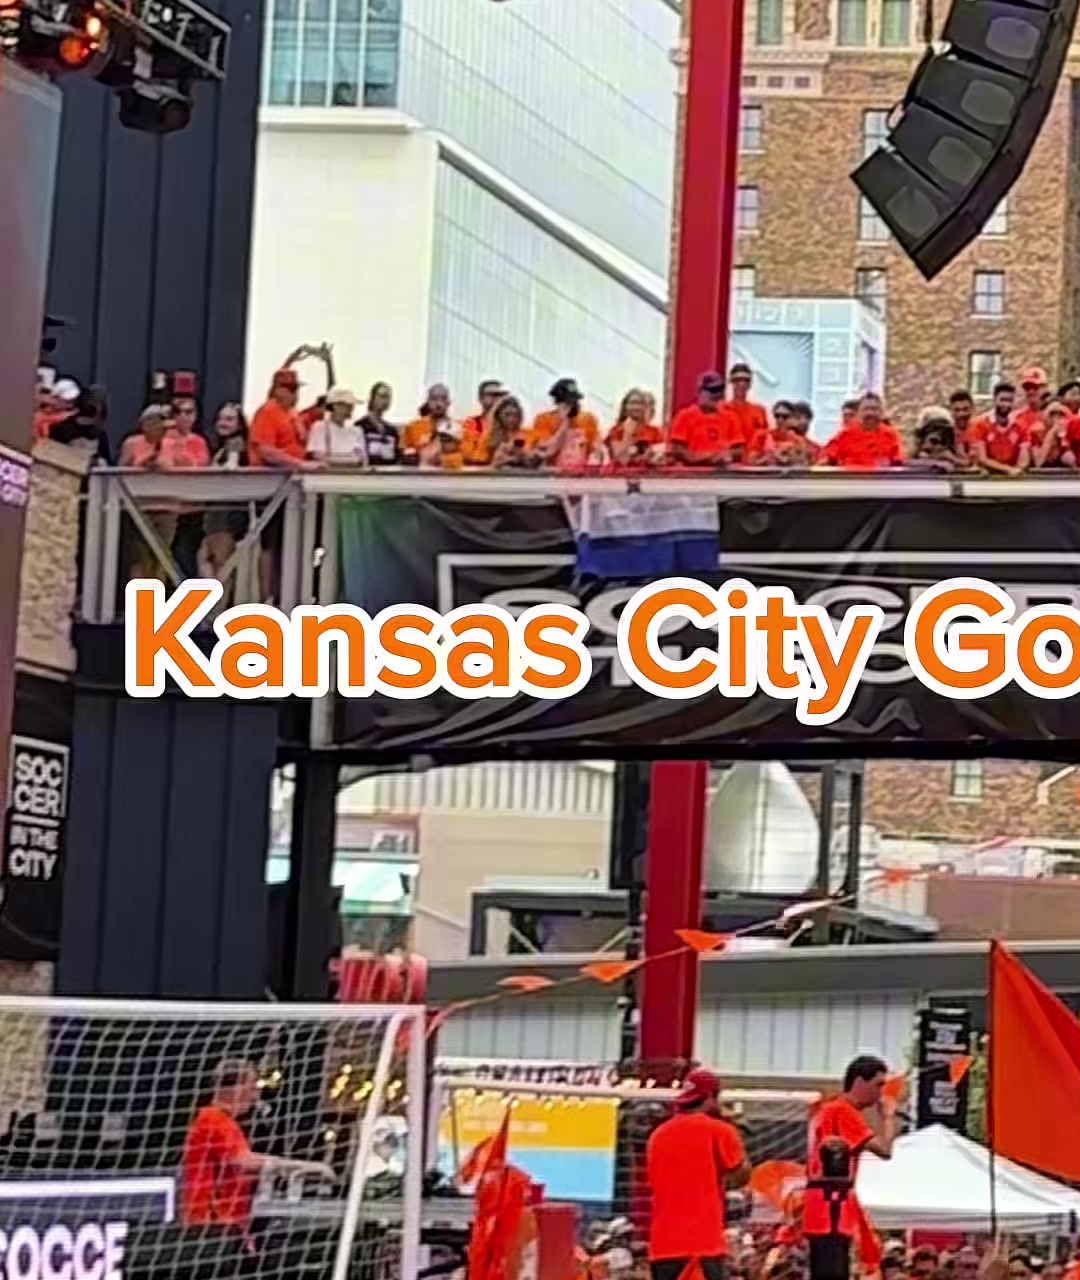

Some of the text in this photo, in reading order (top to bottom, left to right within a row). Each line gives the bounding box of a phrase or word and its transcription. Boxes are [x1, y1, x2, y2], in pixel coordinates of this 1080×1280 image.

[15, 751, 63, 788] SOC
[14, 783, 61, 817] CER
[8, 847, 58, 882] CITY
